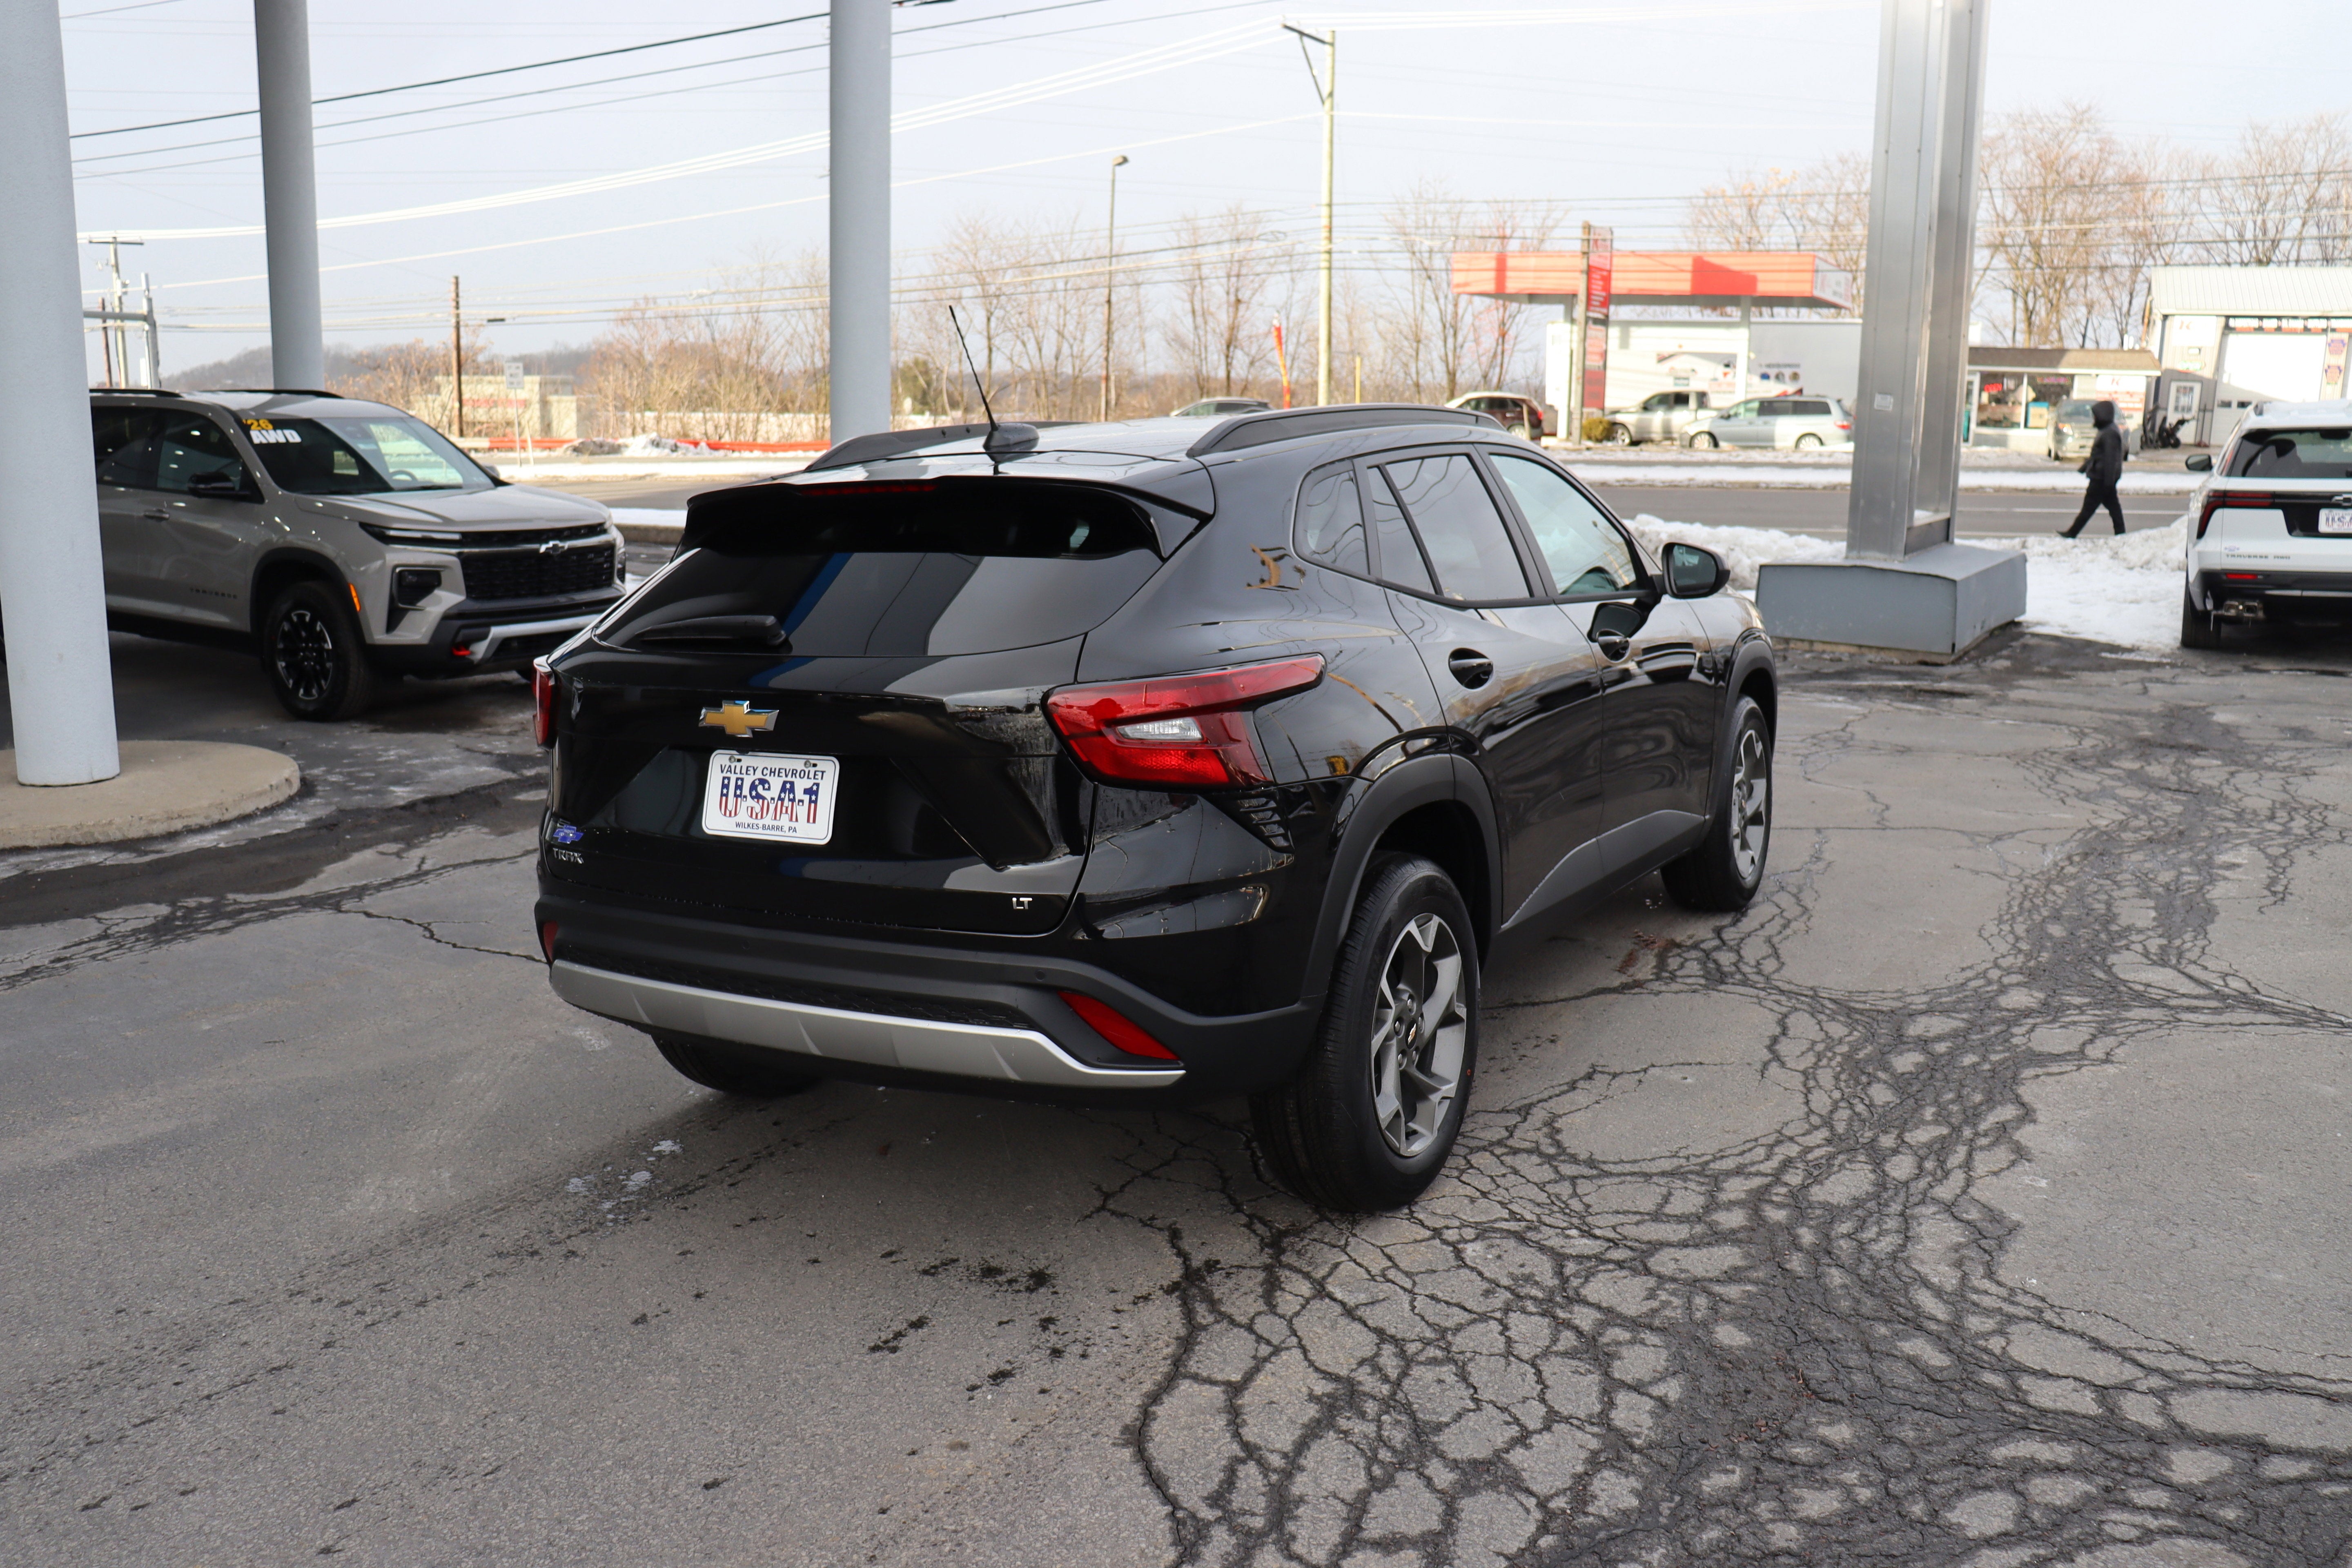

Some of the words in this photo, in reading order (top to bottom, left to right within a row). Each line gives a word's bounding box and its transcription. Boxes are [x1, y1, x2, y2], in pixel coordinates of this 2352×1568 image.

[249, 429, 302, 444] AWD
[720, 764, 759, 776] VALLEY
[762, 767, 826, 780] CHEVROLET
[735, 822, 786, 833] WILKES-BARRE,
[552, 847, 584, 864] TRAX
[1012, 898, 1032, 909] LT
